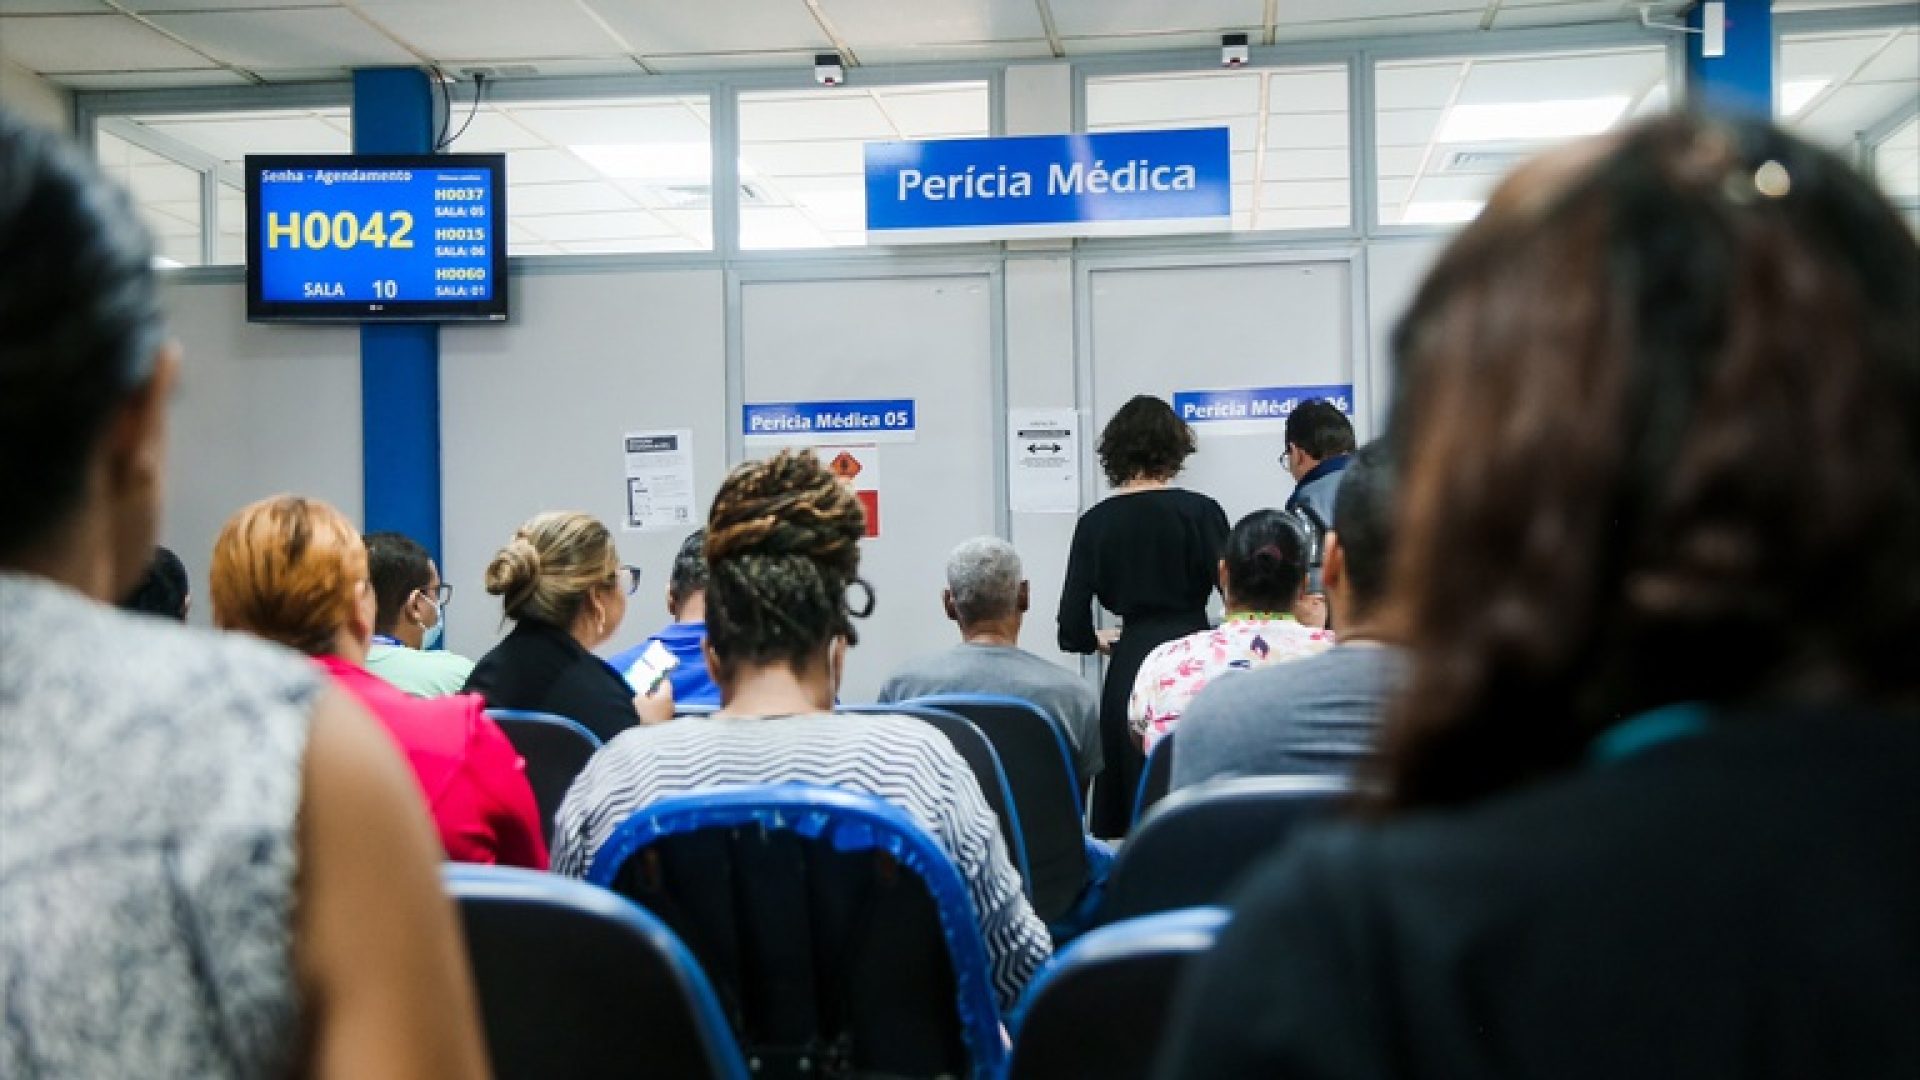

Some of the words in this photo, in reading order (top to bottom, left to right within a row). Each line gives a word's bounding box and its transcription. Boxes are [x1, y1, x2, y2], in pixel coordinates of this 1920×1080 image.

[262, 169, 303, 183] Senha
[315, 169, 412, 185] Agendamento
[898, 164, 1032, 200] Perícia
[1049, 160, 1196, 195] Médica
[267, 211, 415, 249] H0042
[303, 282, 345, 297] SALA
[372, 280, 397, 298] 10
[815, 411, 880, 428] Médica
[884, 410, 909, 426] 05
